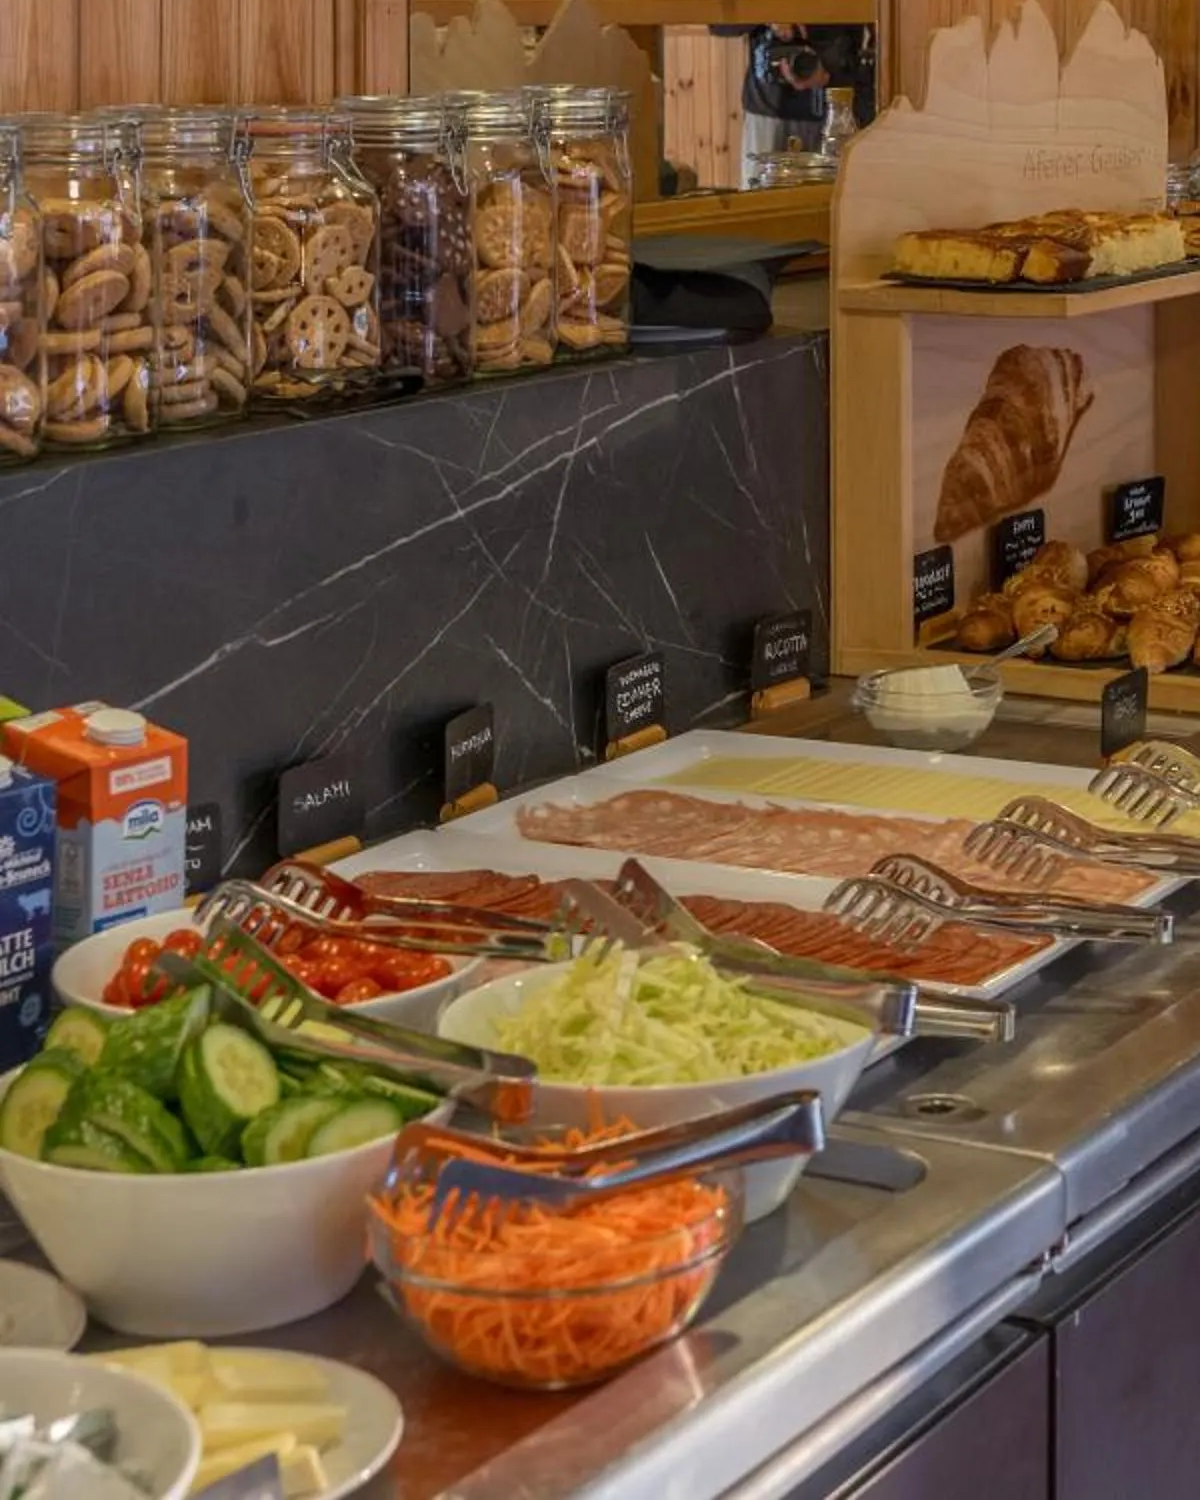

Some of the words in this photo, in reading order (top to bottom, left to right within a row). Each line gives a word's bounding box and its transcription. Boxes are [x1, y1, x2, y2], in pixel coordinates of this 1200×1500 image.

[764, 633, 807, 660] RICOTTA
[293, 780, 351, 813] SALAMI
[103, 864, 153, 891] SENZA
[103, 873, 179, 910] LATTOSIO
